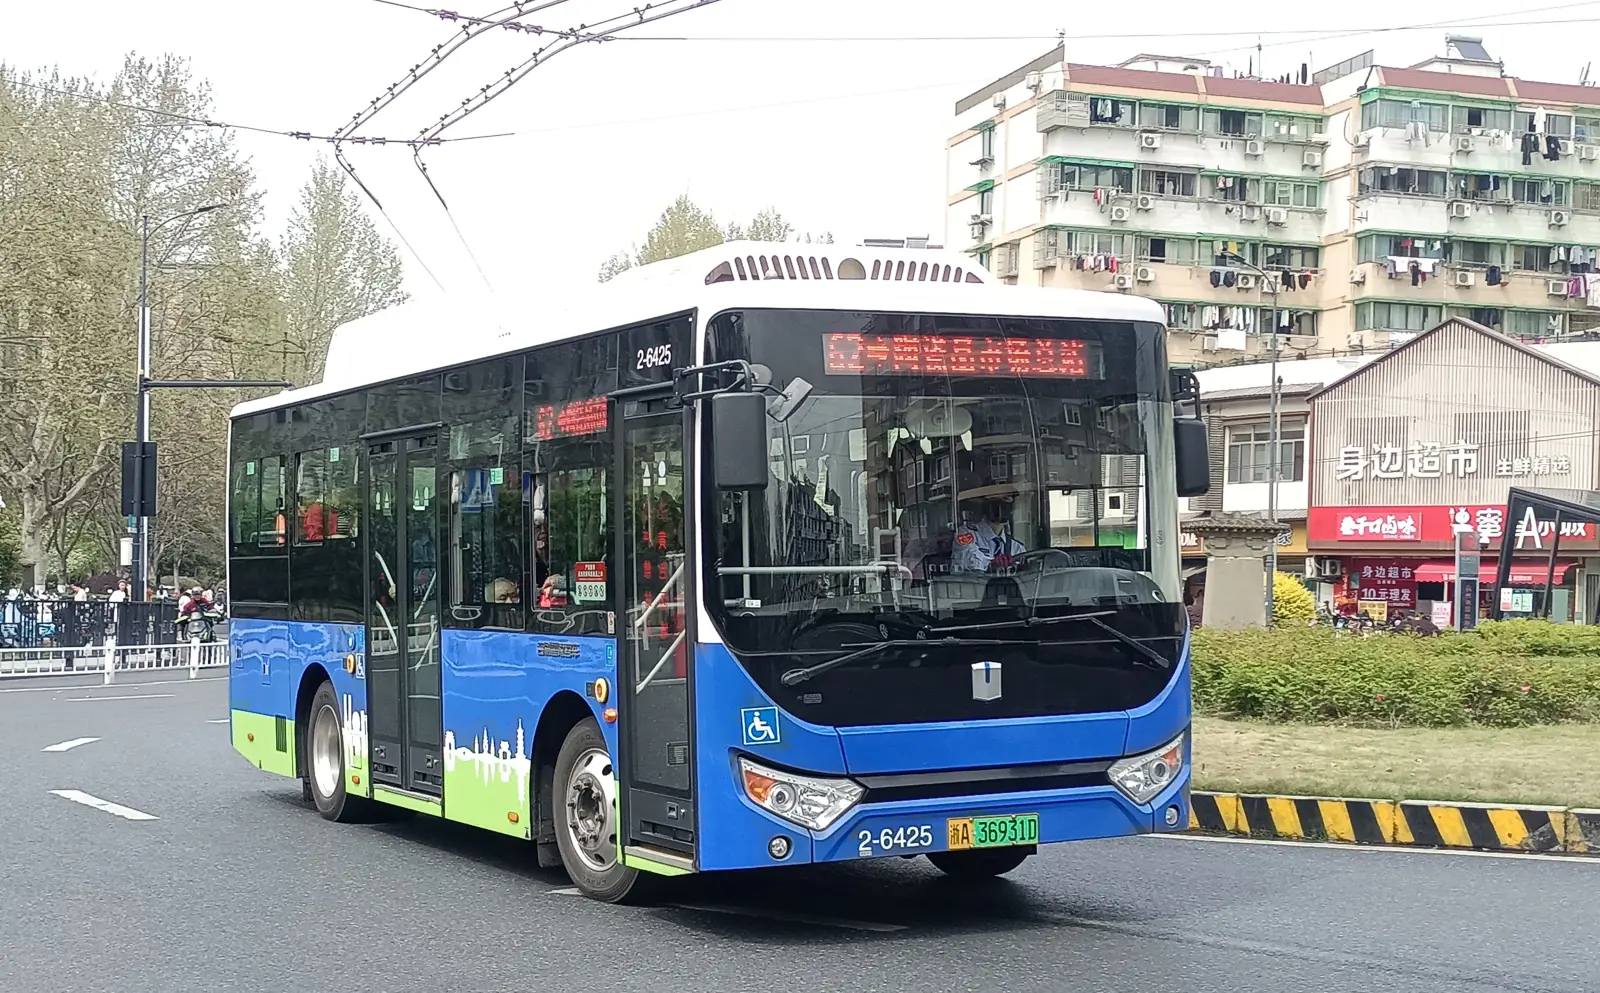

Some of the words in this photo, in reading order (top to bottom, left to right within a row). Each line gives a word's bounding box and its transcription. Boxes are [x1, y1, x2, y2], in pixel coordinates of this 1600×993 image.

[637, 344, 671, 369] 2-6425
[1336, 439, 1480, 481] 身边超市
[1496, 455, 1571, 476] 生鲜精选
[1515, 507, 1542, 549] A
[1362, 565, 1412, 579] 身边超市
[1361, 587, 1411, 601] 10元理发
[858, 825, 933, 851] 2-6425
[977, 818, 1037, 844] 36931D
